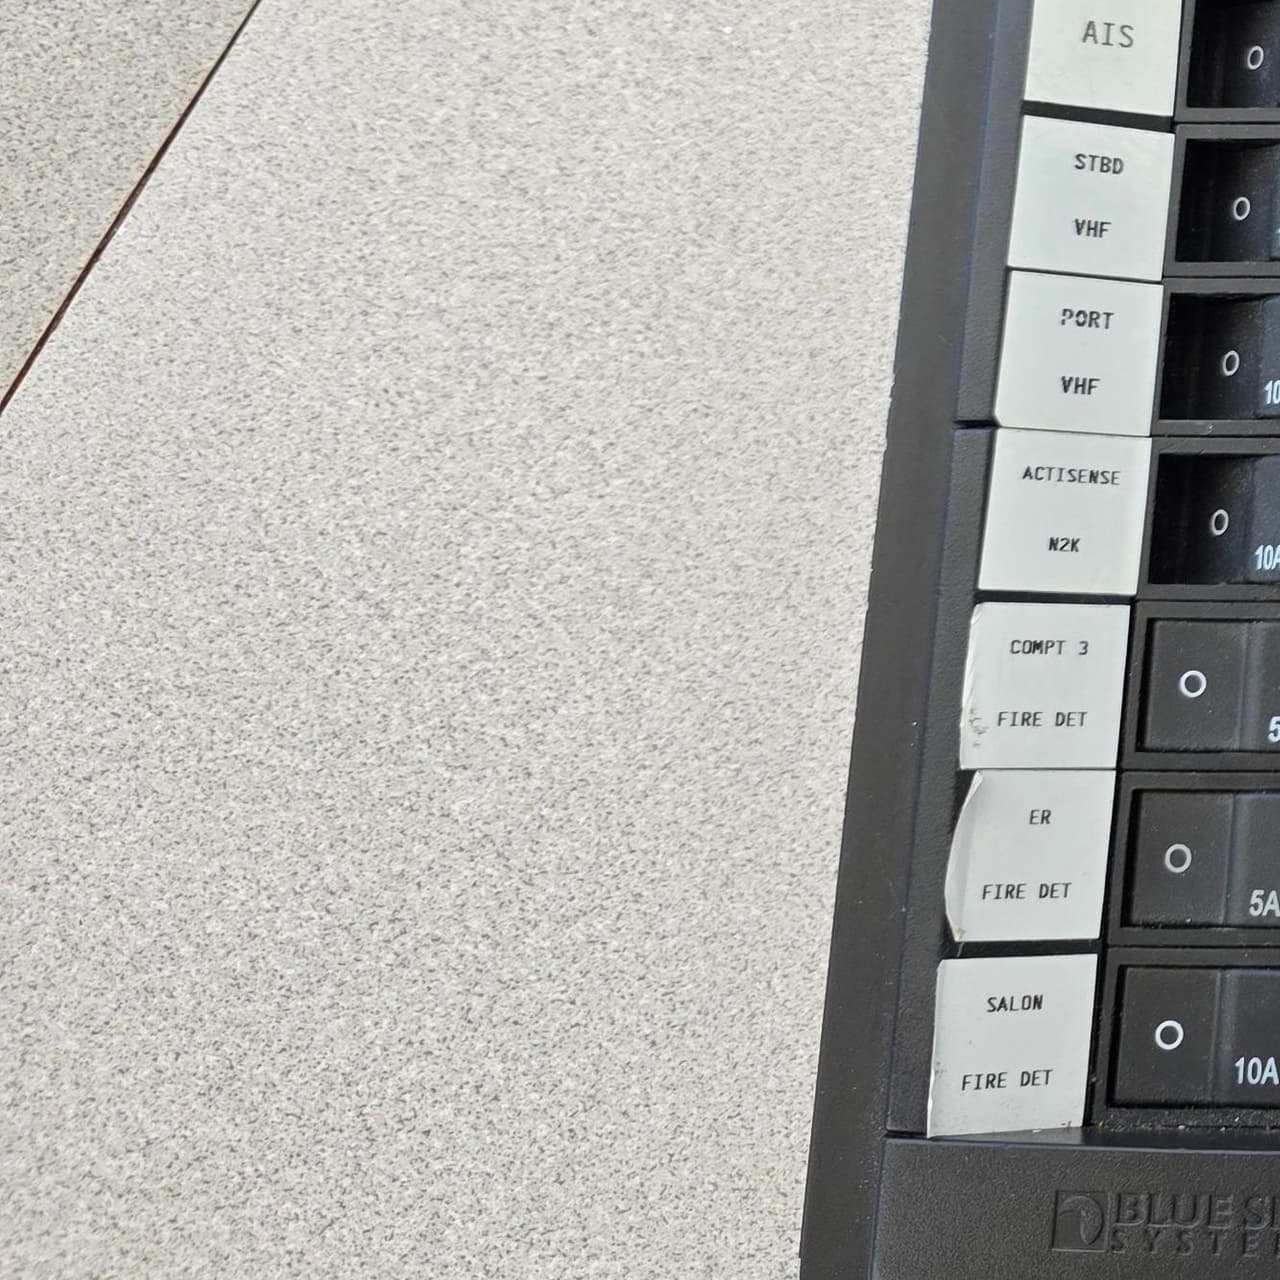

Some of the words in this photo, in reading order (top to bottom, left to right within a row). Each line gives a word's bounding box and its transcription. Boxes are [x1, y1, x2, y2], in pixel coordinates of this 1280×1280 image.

[1081, 19, 1135, 49] AIS
[1073, 152, 1125, 176] STBD
[1074, 217, 1112, 239] VHF
[1060, 307, 1115, 331] PORT
[1061, 375, 1101, 396] VHF
[1021, 465, 1122, 487] ACTISENSE
[1047, 535, 1081, 554] N2K
[1009, 638, 1066, 657] COMPT
[1078, 639, 1090, 657] 3
[996, 711, 1044, 728] FIRE
[1054, 710, 1089, 728] DET
[1028, 807, 1052, 826] ER
[981, 882, 1028, 901] FIRE
[1038, 881, 1073, 899] DET
[1248, 888, 1280, 918] 5A
[985, 993, 1045, 1014] SALON
[961, 1070, 1008, 1091] FIRE
[1019, 1068, 1053, 1088] DET
[1233, 1055, 1280, 1087] 10A
[1112, 1192, 1235, 1229] BLUE
